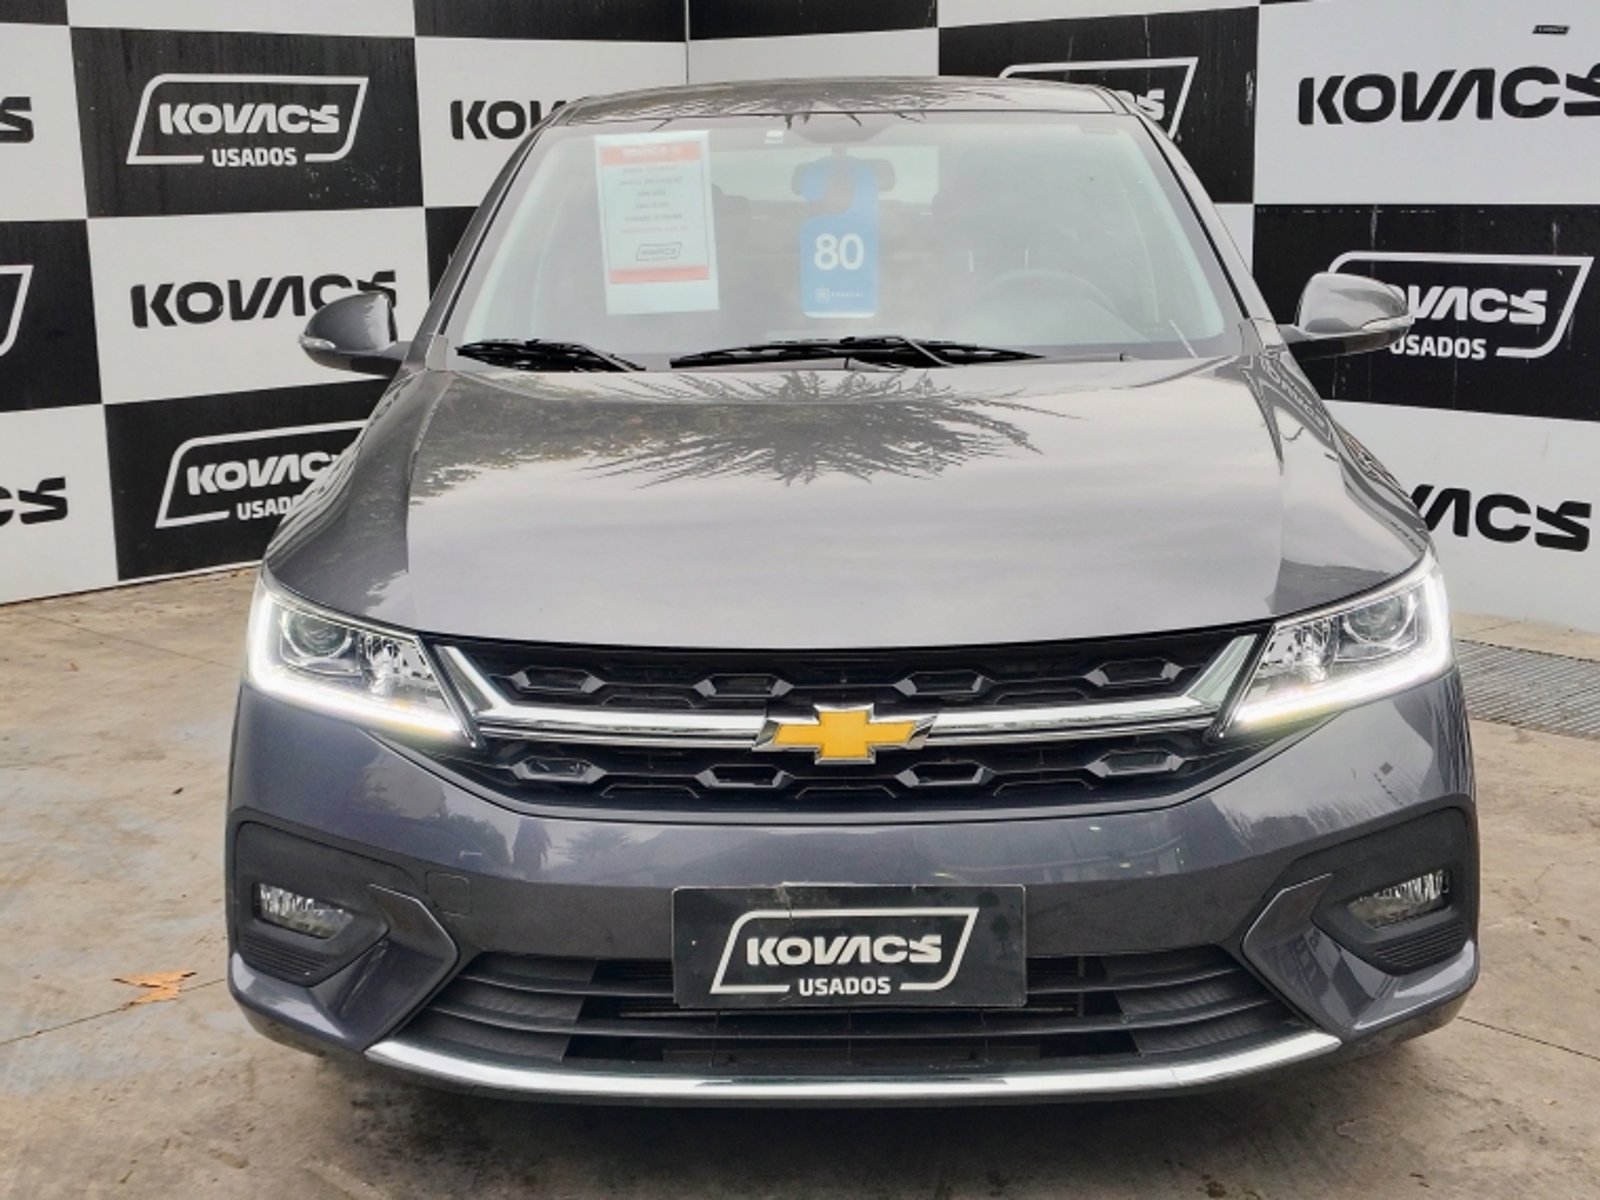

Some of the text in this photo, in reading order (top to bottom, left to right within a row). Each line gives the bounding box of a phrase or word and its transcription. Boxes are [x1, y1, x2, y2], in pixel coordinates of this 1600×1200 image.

[159, 103, 340, 135] KOVACS
[212, 147, 298, 167] USADOS
[814, 233, 864, 270] 80
[1386, 284, 1547, 325] VACS
[187, 451, 340, 496] KOVAC
[746, 934, 942, 966] KOVACS
[799, 977, 891, 996] USADOS
